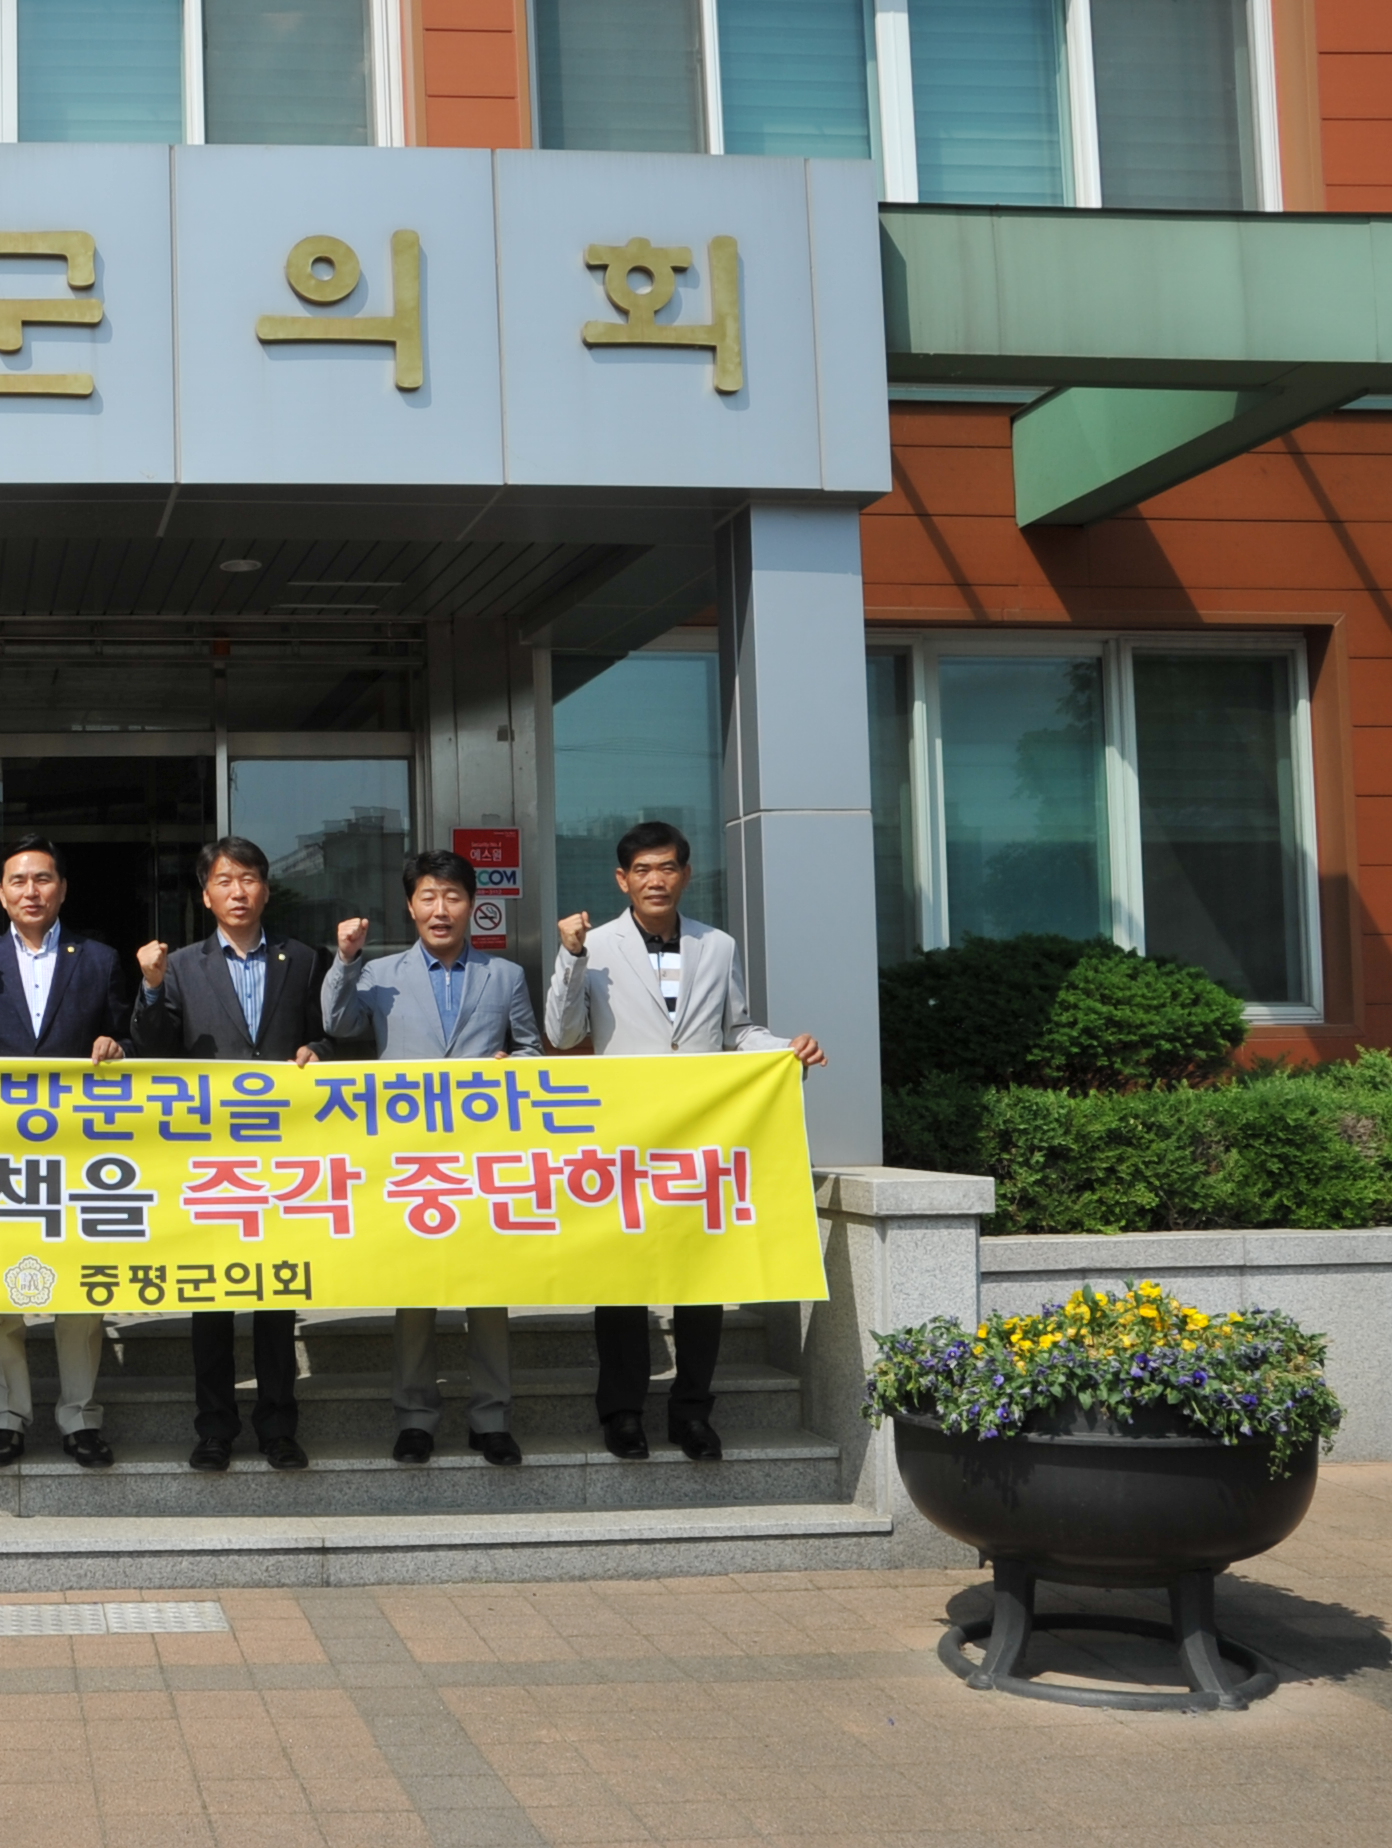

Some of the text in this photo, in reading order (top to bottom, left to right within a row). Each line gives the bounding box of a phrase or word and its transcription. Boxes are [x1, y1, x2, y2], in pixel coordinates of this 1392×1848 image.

[470, 849, 502, 862] 에스원
[314, 1069, 602, 1136] 저해하는
[181, 1155, 364, 1240] 즉각
[386, 1146, 755, 1236] 중단하라!
[80, 1260, 312, 1306] 증평군의회
